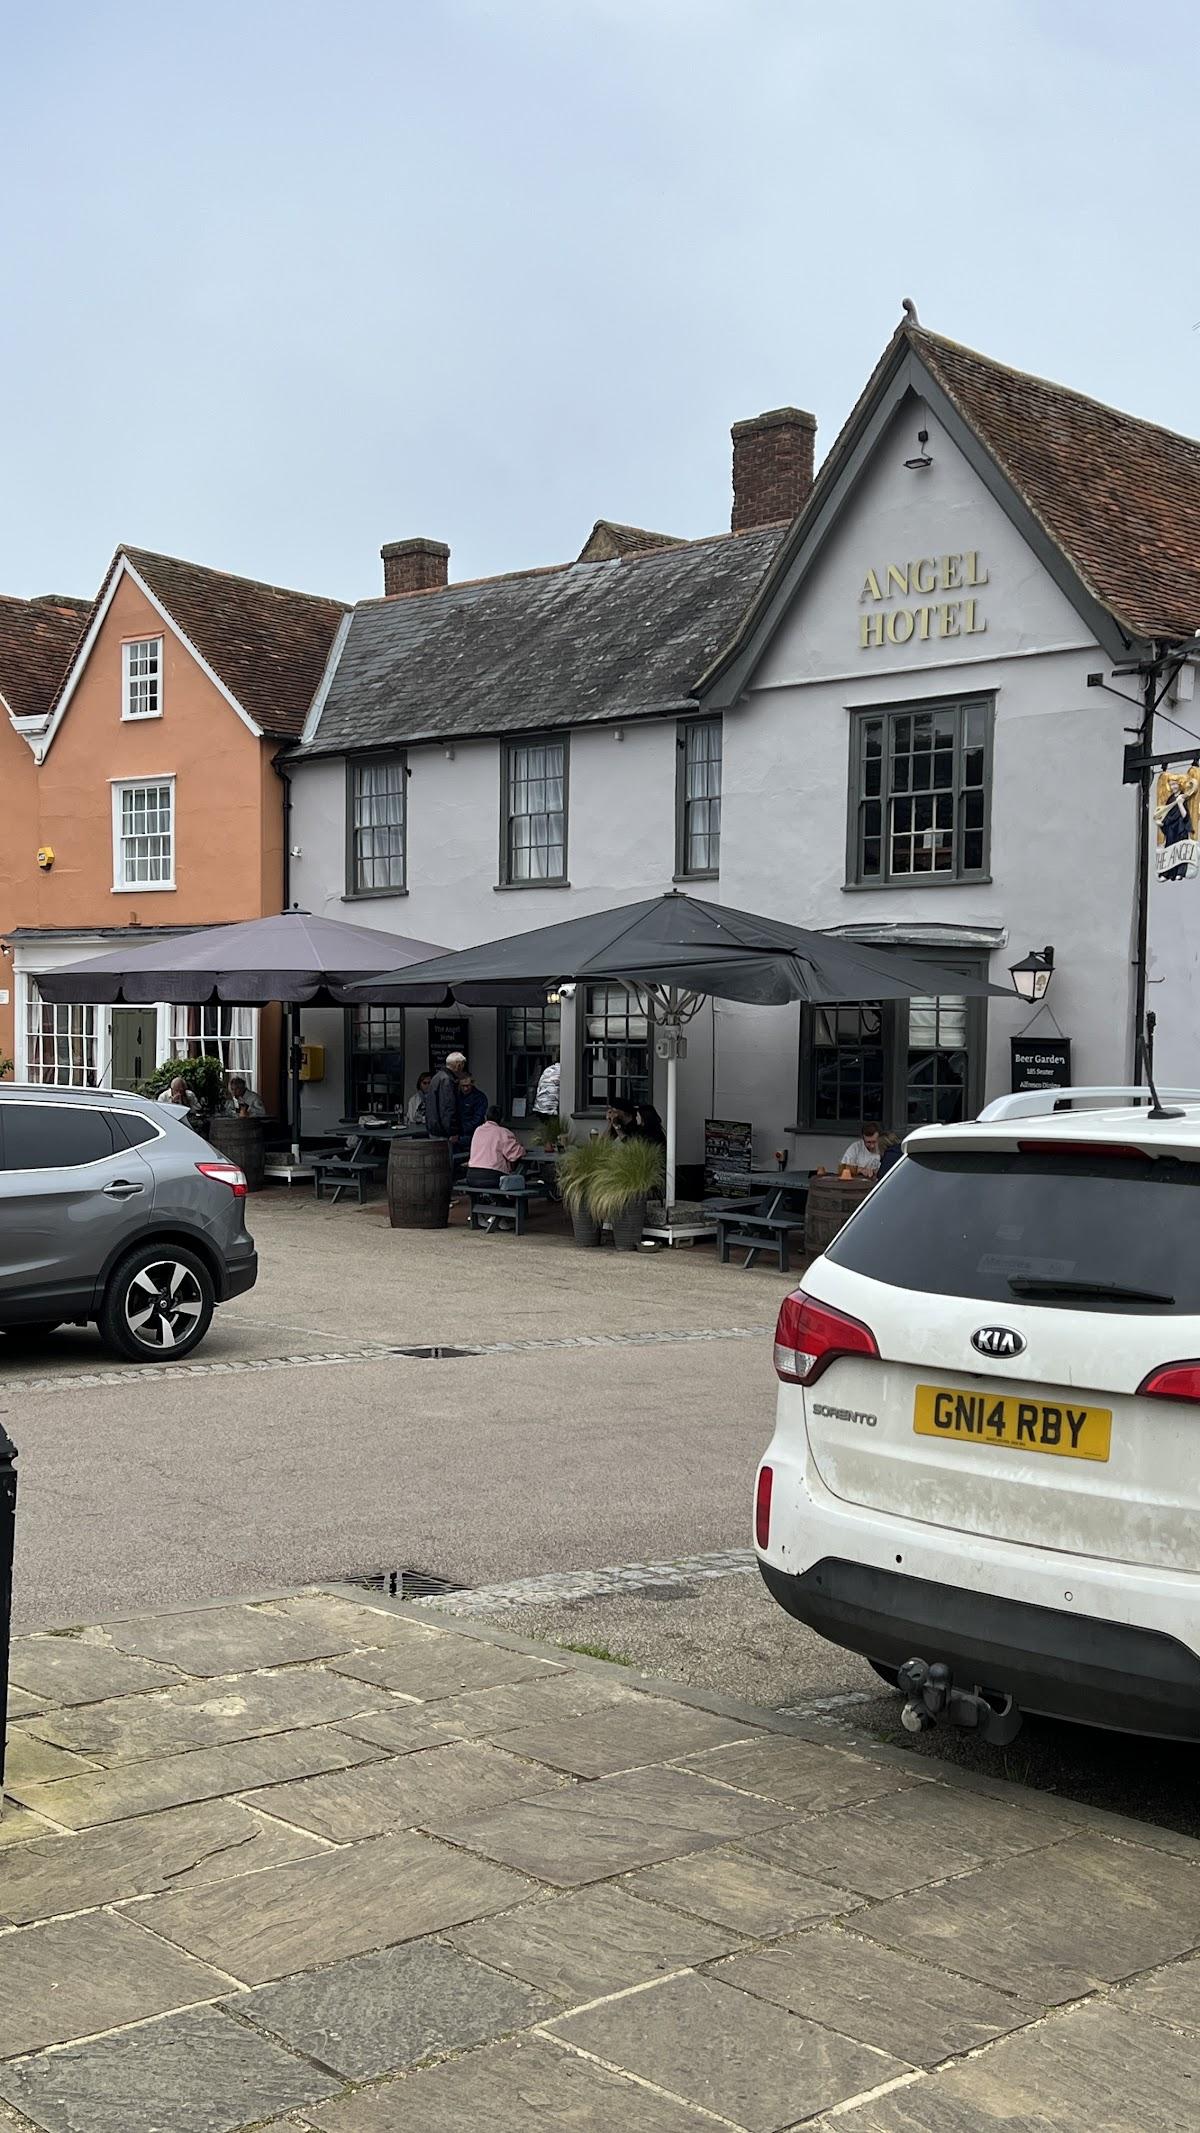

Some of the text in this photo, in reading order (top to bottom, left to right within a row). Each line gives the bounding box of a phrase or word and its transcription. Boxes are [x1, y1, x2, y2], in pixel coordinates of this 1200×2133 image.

[859, 550, 988, 603] ANGEL
[859, 599, 987, 648] HOTEL
[1168, 843, 1196, 867] ANGEL
[1015, 1054, 1065, 1064] Beer Garden
[978, 1330, 1015, 1353] KIA
[812, 1403, 878, 1427] SORENTO
[934, 1393, 1088, 1449] GN14 RBY
